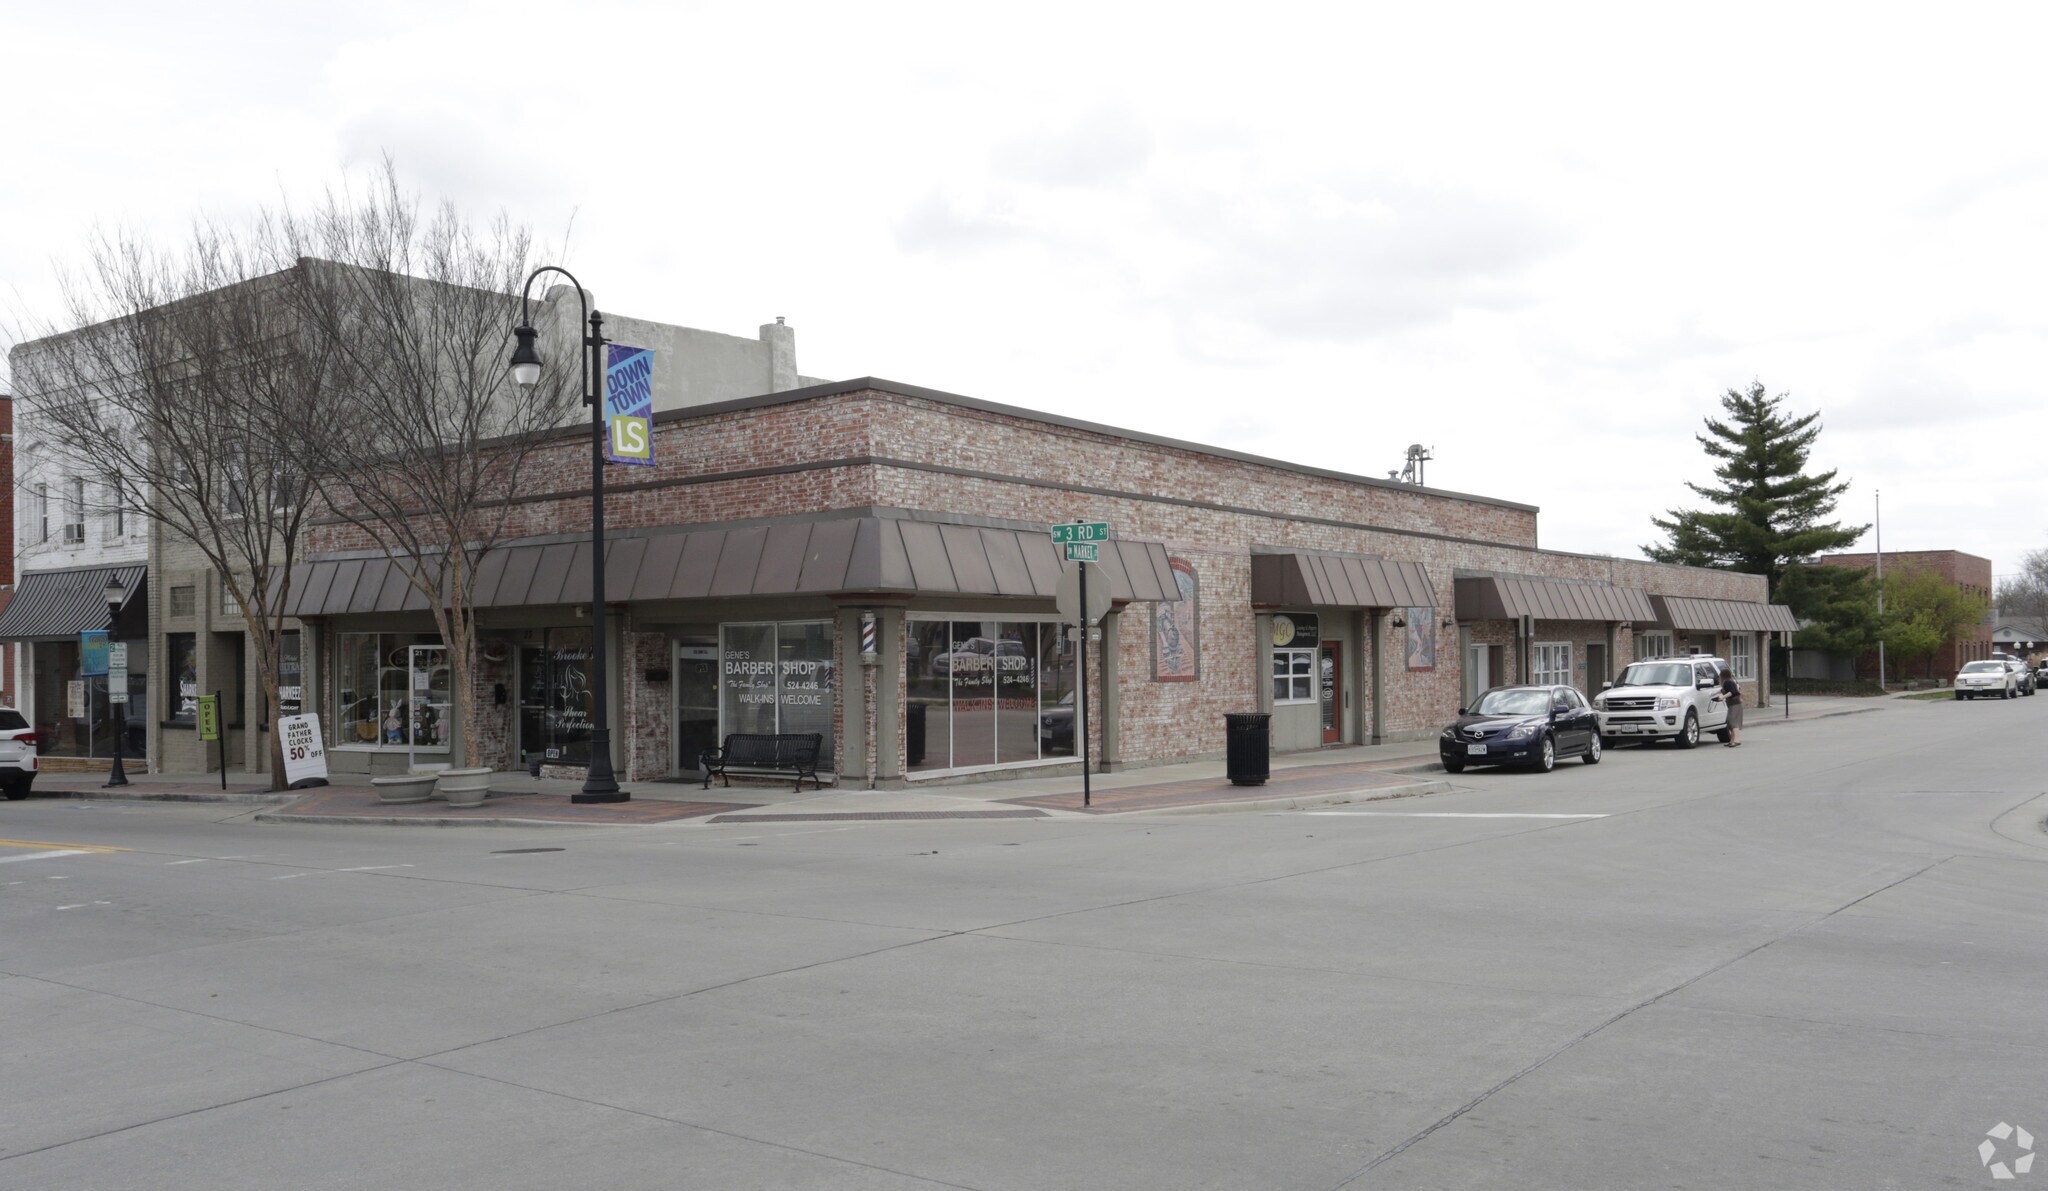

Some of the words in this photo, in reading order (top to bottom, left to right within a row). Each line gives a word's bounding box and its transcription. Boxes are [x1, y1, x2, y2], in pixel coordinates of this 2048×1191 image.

[607, 356, 650, 394] DOWN
[608, 378, 651, 414] TOWN
[615, 419, 645, 453] LS
[1066, 526, 1073, 540] 3
[1078, 525, 1094, 540] RD
[1099, 527, 1107, 536] ST
[1073, 544, 1093, 559] MARKET
[952, 641, 976, 650] GENE'S
[553, 646, 594, 660] Brooke's
[724, 651, 750, 660] GENE'S
[725, 662, 774, 675] BARBER
[782, 661, 816, 675] SHOP
[952, 657, 994, 672] BARBER
[1002, 657, 1026, 671] SHOP
[279, 686, 301, 700] HARKEEZ
[738, 694, 775, 704] WALK-INS
[781, 694, 822, 705] WELCOME
[954, 698, 993, 712] WALK-INS
[999, 696, 1037, 710] WELCOME
[204, 703, 212, 733] OPEN
[288, 722, 309, 731] GRAND
[555, 718, 595, 733] Perfection
[287, 729, 313, 739] FATHER
[288, 737, 313, 747] CLOCKS
[310, 750, 323, 758] OFF
